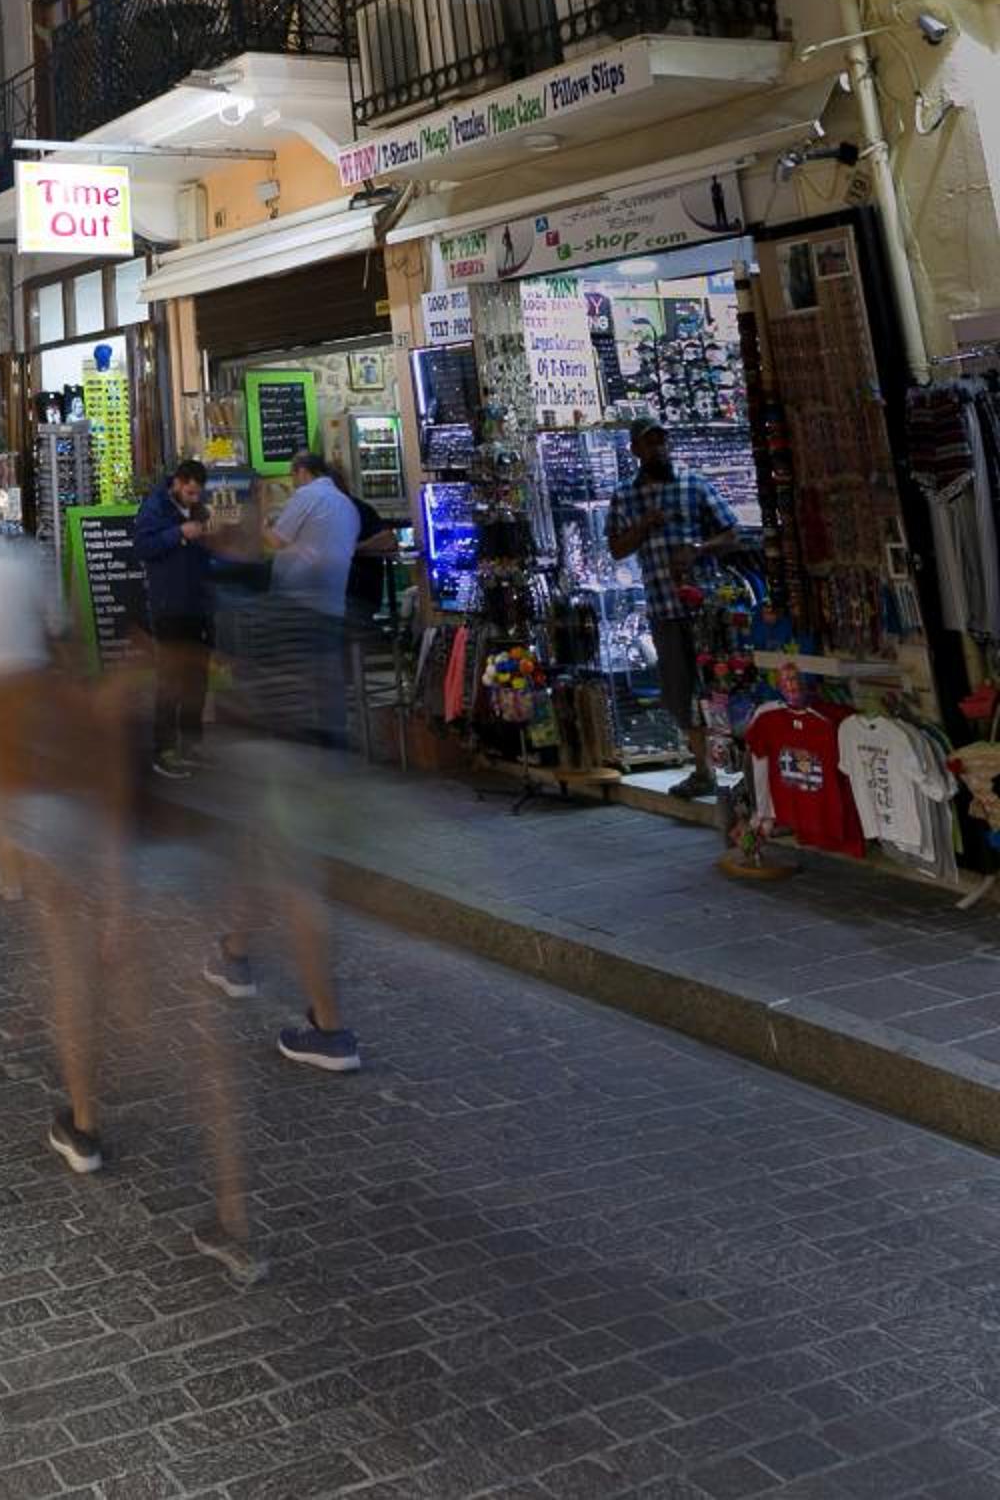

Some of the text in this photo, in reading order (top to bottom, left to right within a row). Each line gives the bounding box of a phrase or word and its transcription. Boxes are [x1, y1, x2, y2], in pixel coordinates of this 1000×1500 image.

[550, 74, 590, 111] Pillow
[591, 61, 625, 94] Slips
[37, 179, 120, 206] Time
[50, 211, 110, 237] Out
